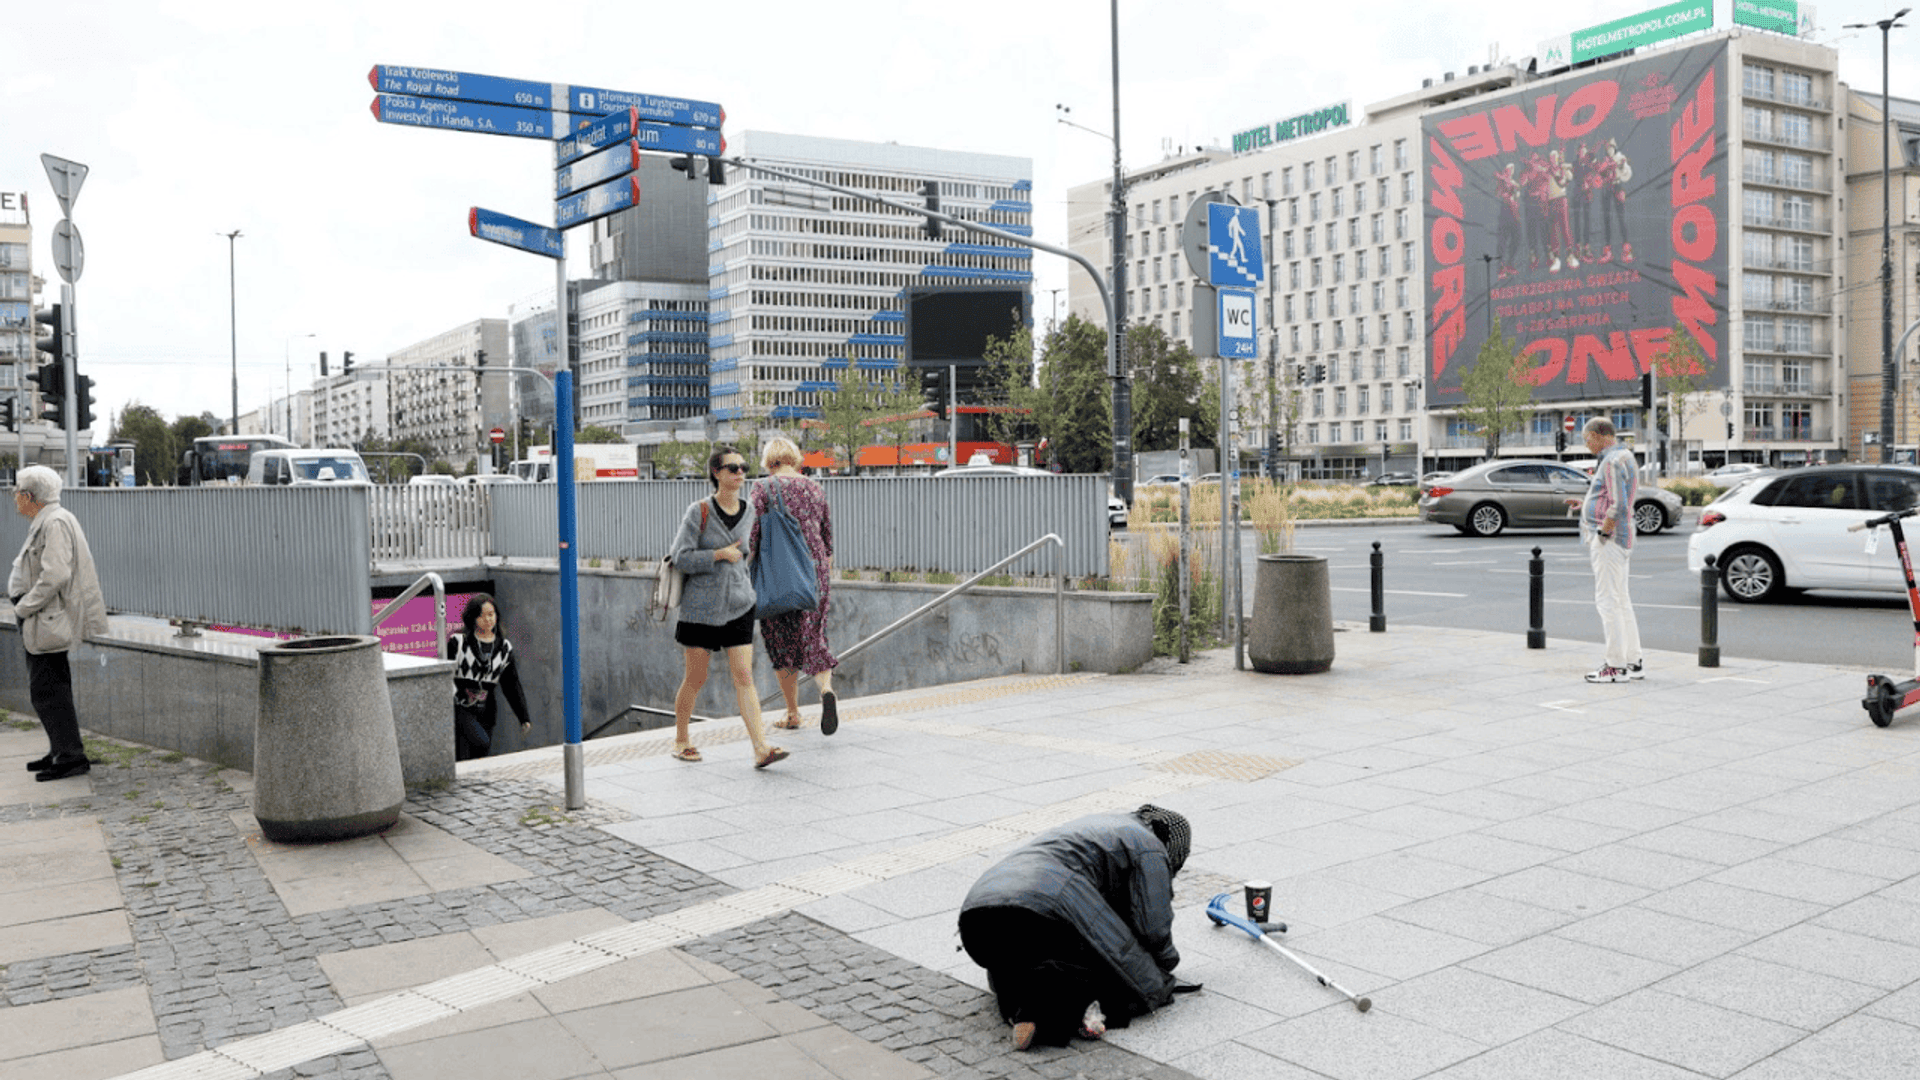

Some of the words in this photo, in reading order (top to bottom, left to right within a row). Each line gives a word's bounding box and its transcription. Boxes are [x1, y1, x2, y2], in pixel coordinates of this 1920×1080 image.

[1575, 6, 1707, 52] HOTELMETROPOL.COM.PL
[384, 66, 409, 77] Trakt
[411, 67, 459, 83] Królewski
[384, 79, 403, 90] The
[406, 81, 432, 94] Royal
[435, 83, 460, 95] Road
[385, 96, 416, 108] Polska
[420, 99, 458, 114] Agencja
[514, 92, 533, 104] 650
[534, 95, 544, 105] m
[385, 110, 432, 125] Inwestycji
[442, 114, 474, 127] Handlu
[477, 117, 496, 129] S.A.
[515, 121, 534, 133] 350
[536, 125, 545, 133] m
[1233, 124, 1273, 154] HOTEL
[1276, 102, 1350, 143] METROPOL
[638, 128, 660, 143] um
[1671, 66, 1718, 363] MORE
[1429, 135, 1466, 384] MORE
[1227, 308, 1250, 326] WC
[1235, 342, 1254, 354] 24H
[1508, 327, 1706, 387] ONE
